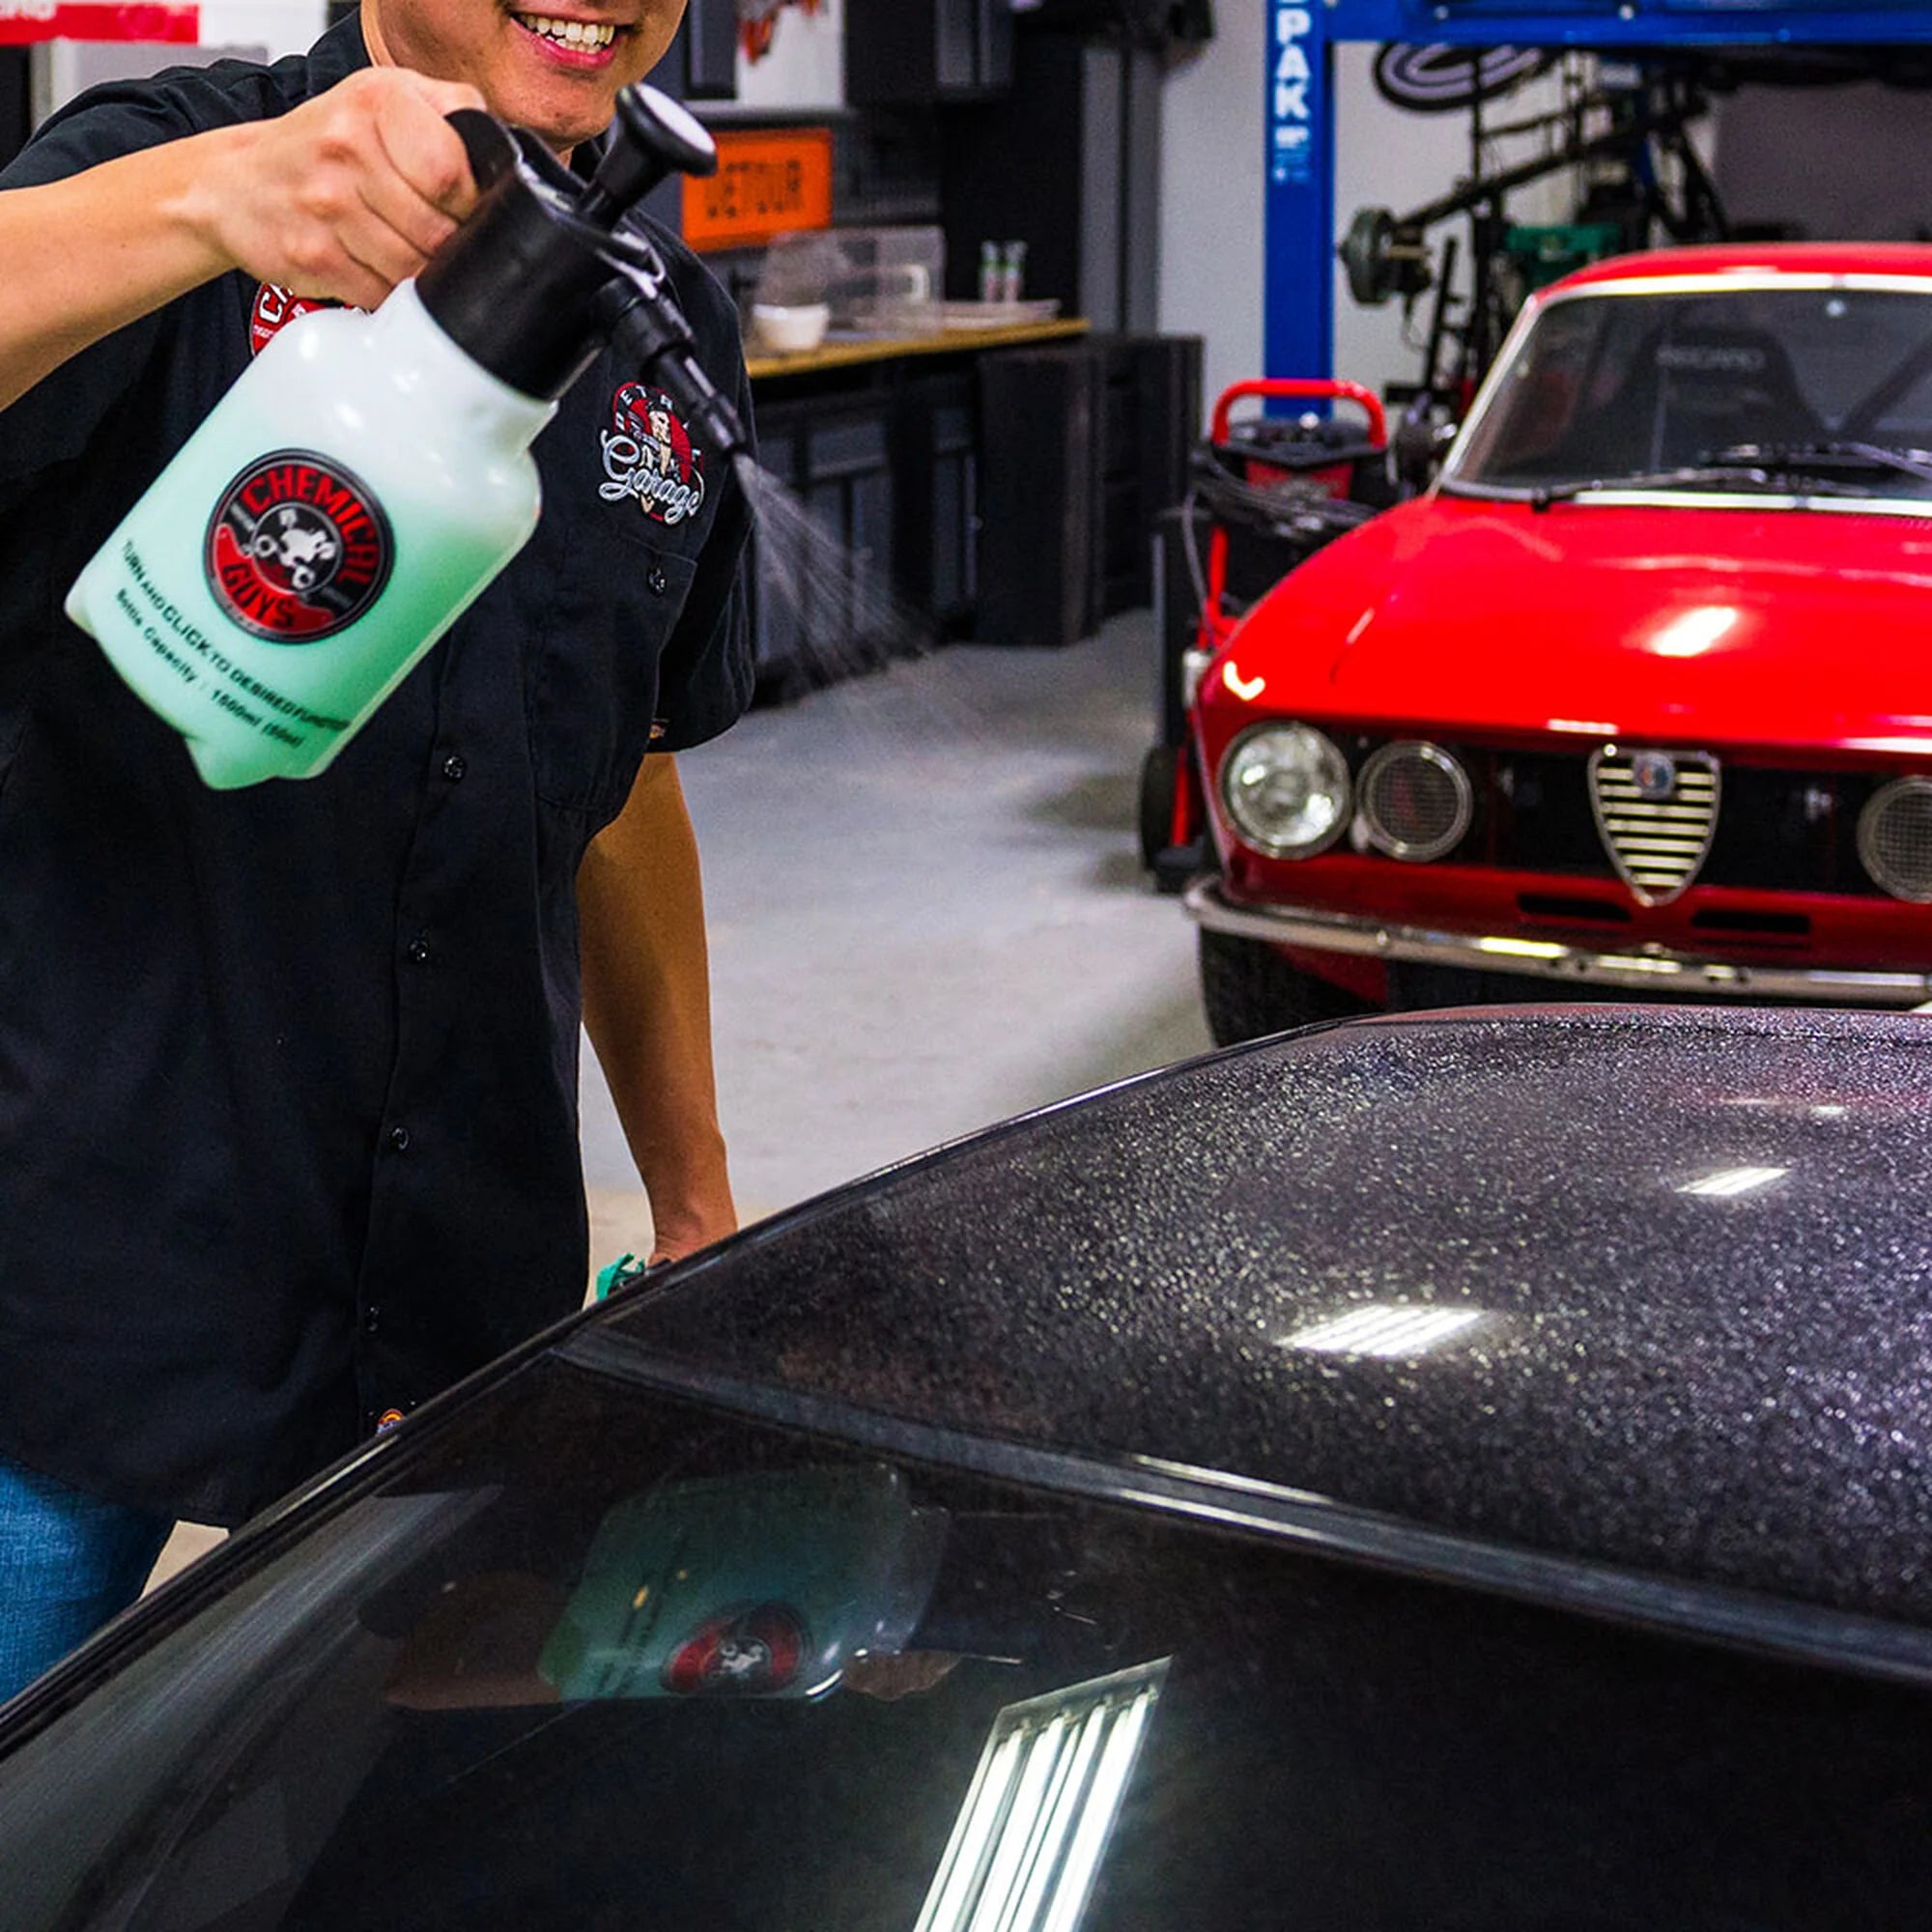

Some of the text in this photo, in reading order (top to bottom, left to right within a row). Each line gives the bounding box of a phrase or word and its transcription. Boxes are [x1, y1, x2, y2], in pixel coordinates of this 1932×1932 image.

[1273, 0, 1313, 120] PAK
[242, 465, 380, 585] CHEMICAL
[161, 605, 212, 657] CLICK
[210, 650, 232, 673] TO
[223, 561, 295, 628] GUYS
